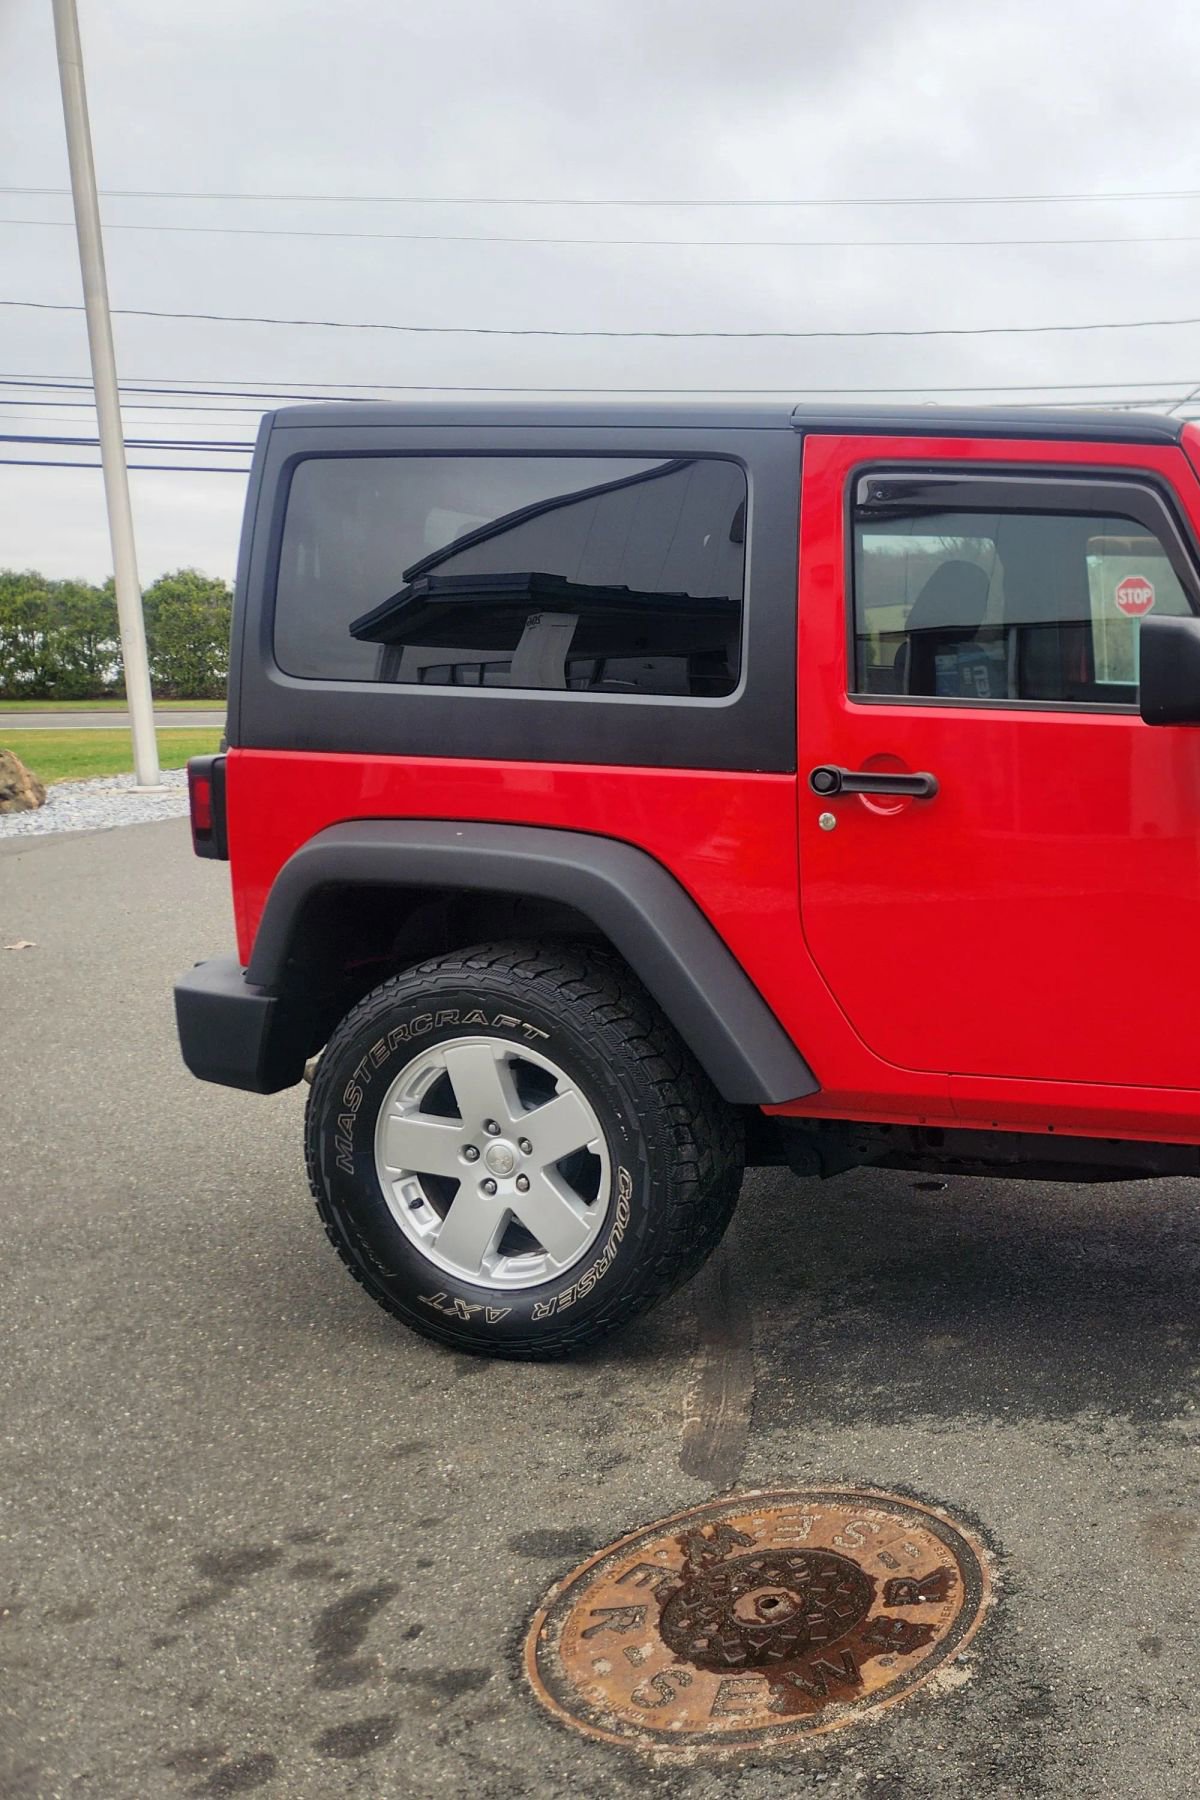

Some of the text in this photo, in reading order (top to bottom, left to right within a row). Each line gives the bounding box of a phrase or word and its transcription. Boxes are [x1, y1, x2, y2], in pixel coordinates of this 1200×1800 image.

[1117, 587, 1153, 605] STOP
[334, 1009, 550, 1174] MASTERCRAFT
[418, 1165, 634, 1324] COURSER AXT
